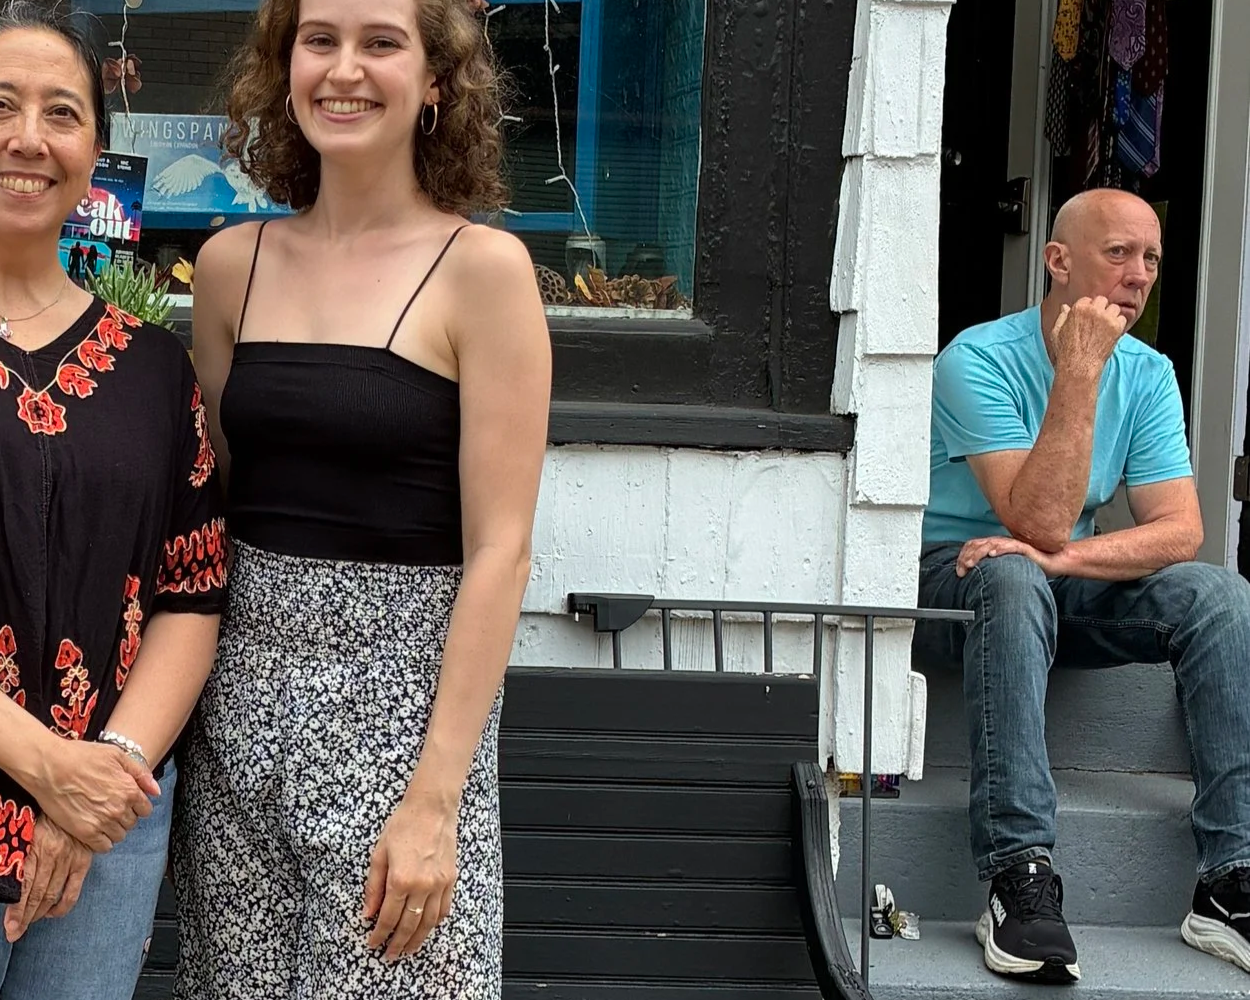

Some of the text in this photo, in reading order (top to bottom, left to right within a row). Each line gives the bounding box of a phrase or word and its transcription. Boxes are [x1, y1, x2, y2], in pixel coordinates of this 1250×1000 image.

[76, 193, 126, 221] eak
[90, 217, 134, 240] out
[990, 893, 1007, 928] HOKA
